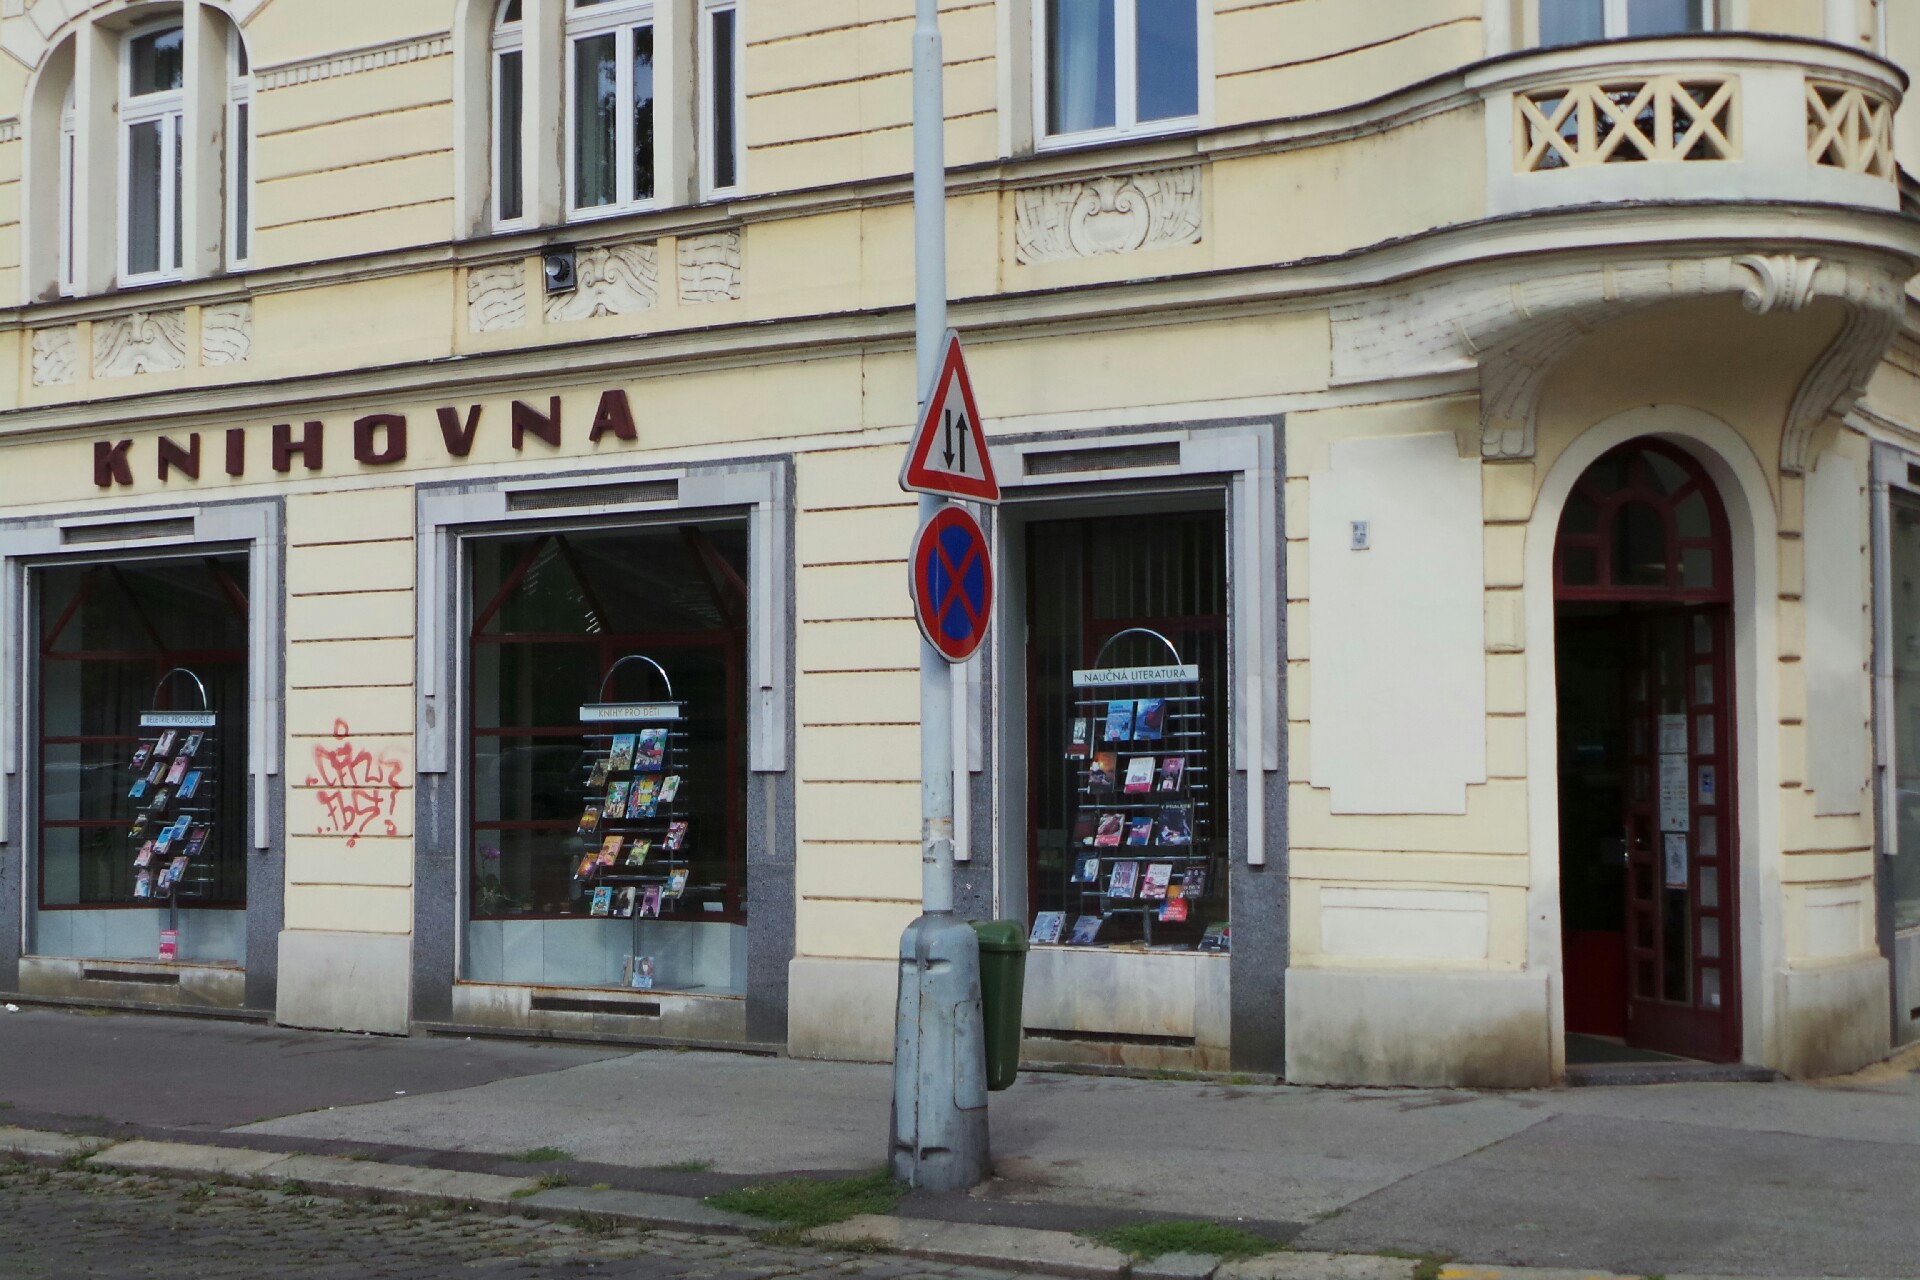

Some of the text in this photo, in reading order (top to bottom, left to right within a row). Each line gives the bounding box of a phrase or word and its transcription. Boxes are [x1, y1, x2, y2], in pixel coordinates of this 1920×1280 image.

[94, 389, 638, 487] KNIHOVNA
[1084, 668, 1187, 683] NAUČNÁ LITERATURA
[598, 709, 623, 718] KNIHY
[625, 708, 641, 717] PRO
[171, 715, 183, 724] PRO
